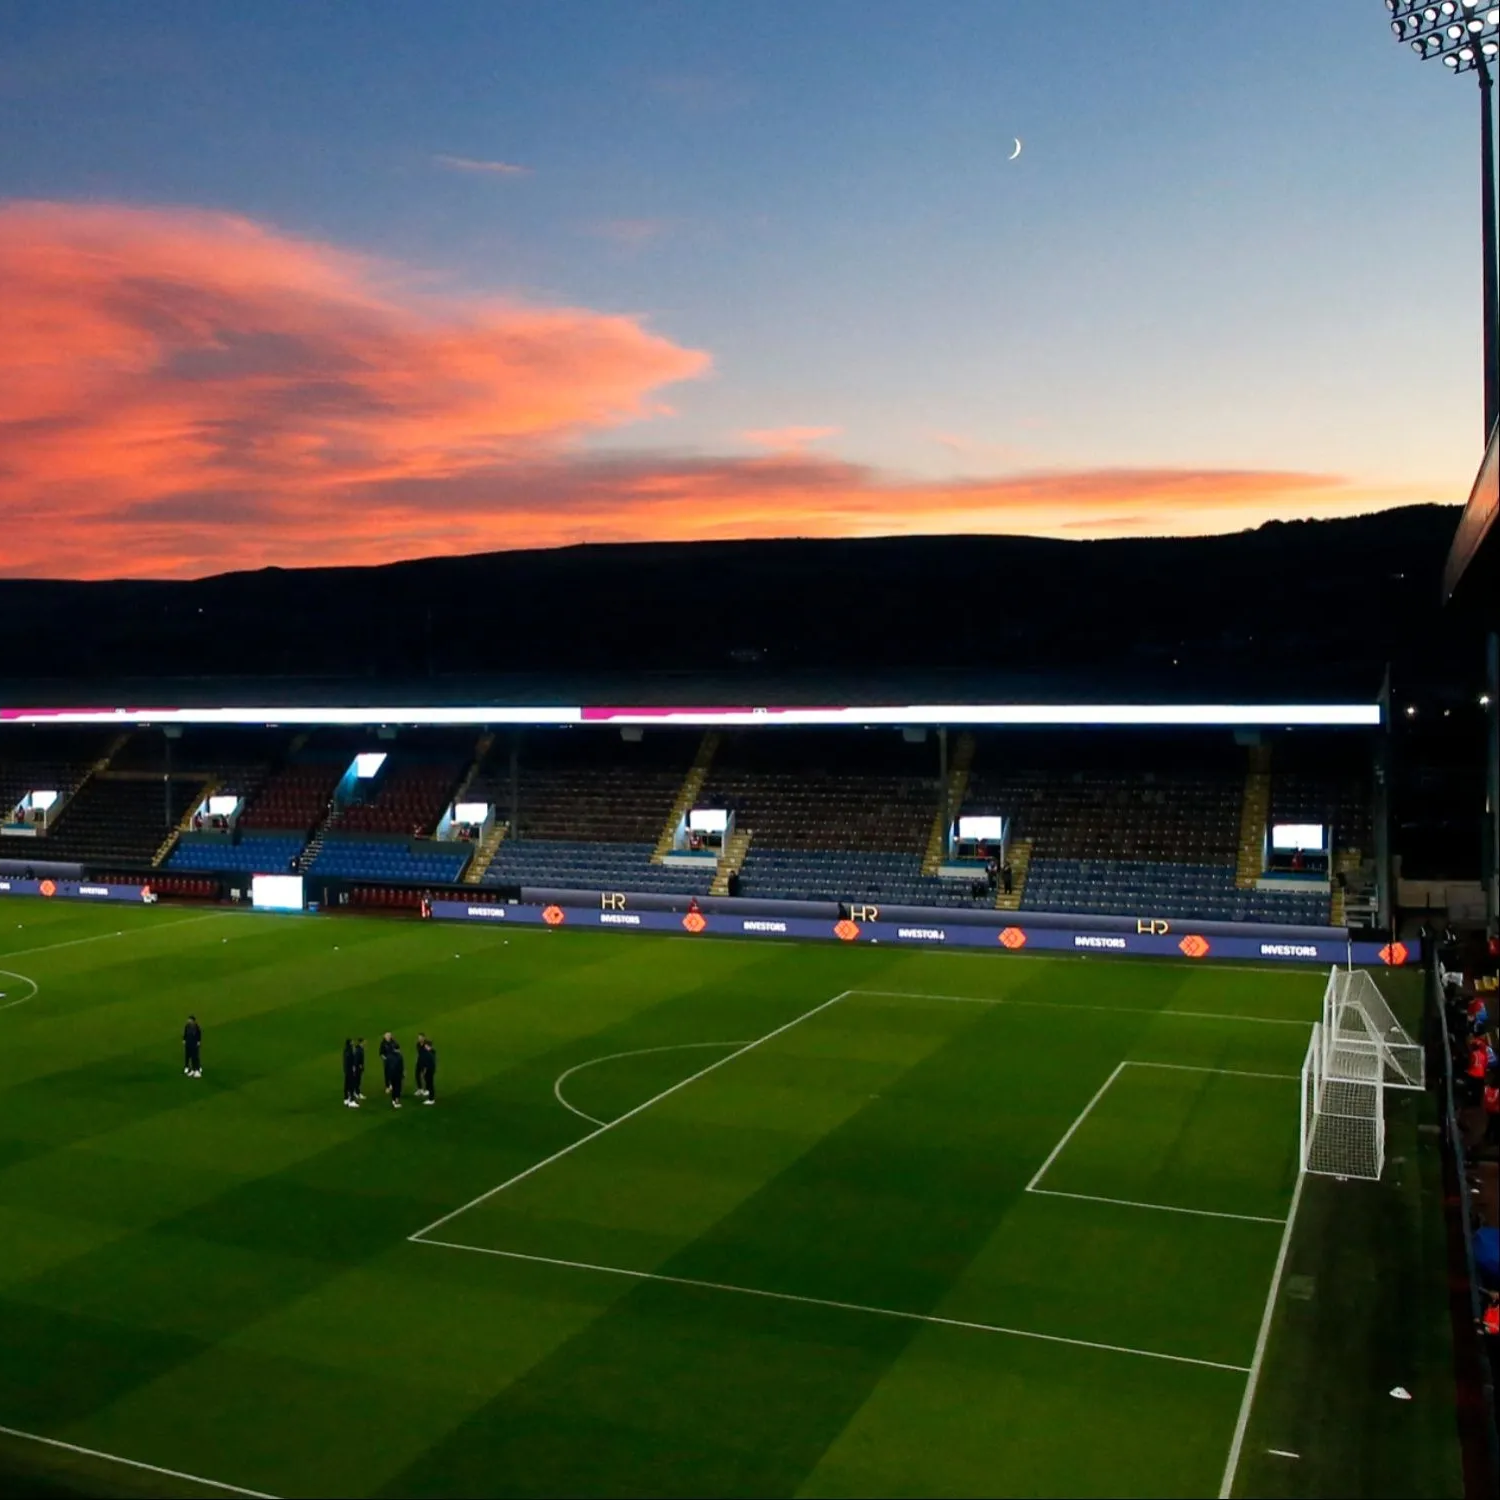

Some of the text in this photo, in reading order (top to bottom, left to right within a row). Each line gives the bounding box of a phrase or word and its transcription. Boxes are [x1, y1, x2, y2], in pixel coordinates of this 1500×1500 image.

[601, 892, 627, 911] HR
[600, 913, 641, 925] INVESTORS
[850, 904, 879, 923] HR
[743, 920, 787, 933] INVESTORS
[1074, 936, 1126, 949] INVESTORS
[1260, 944, 1318, 957] INVESTORS
